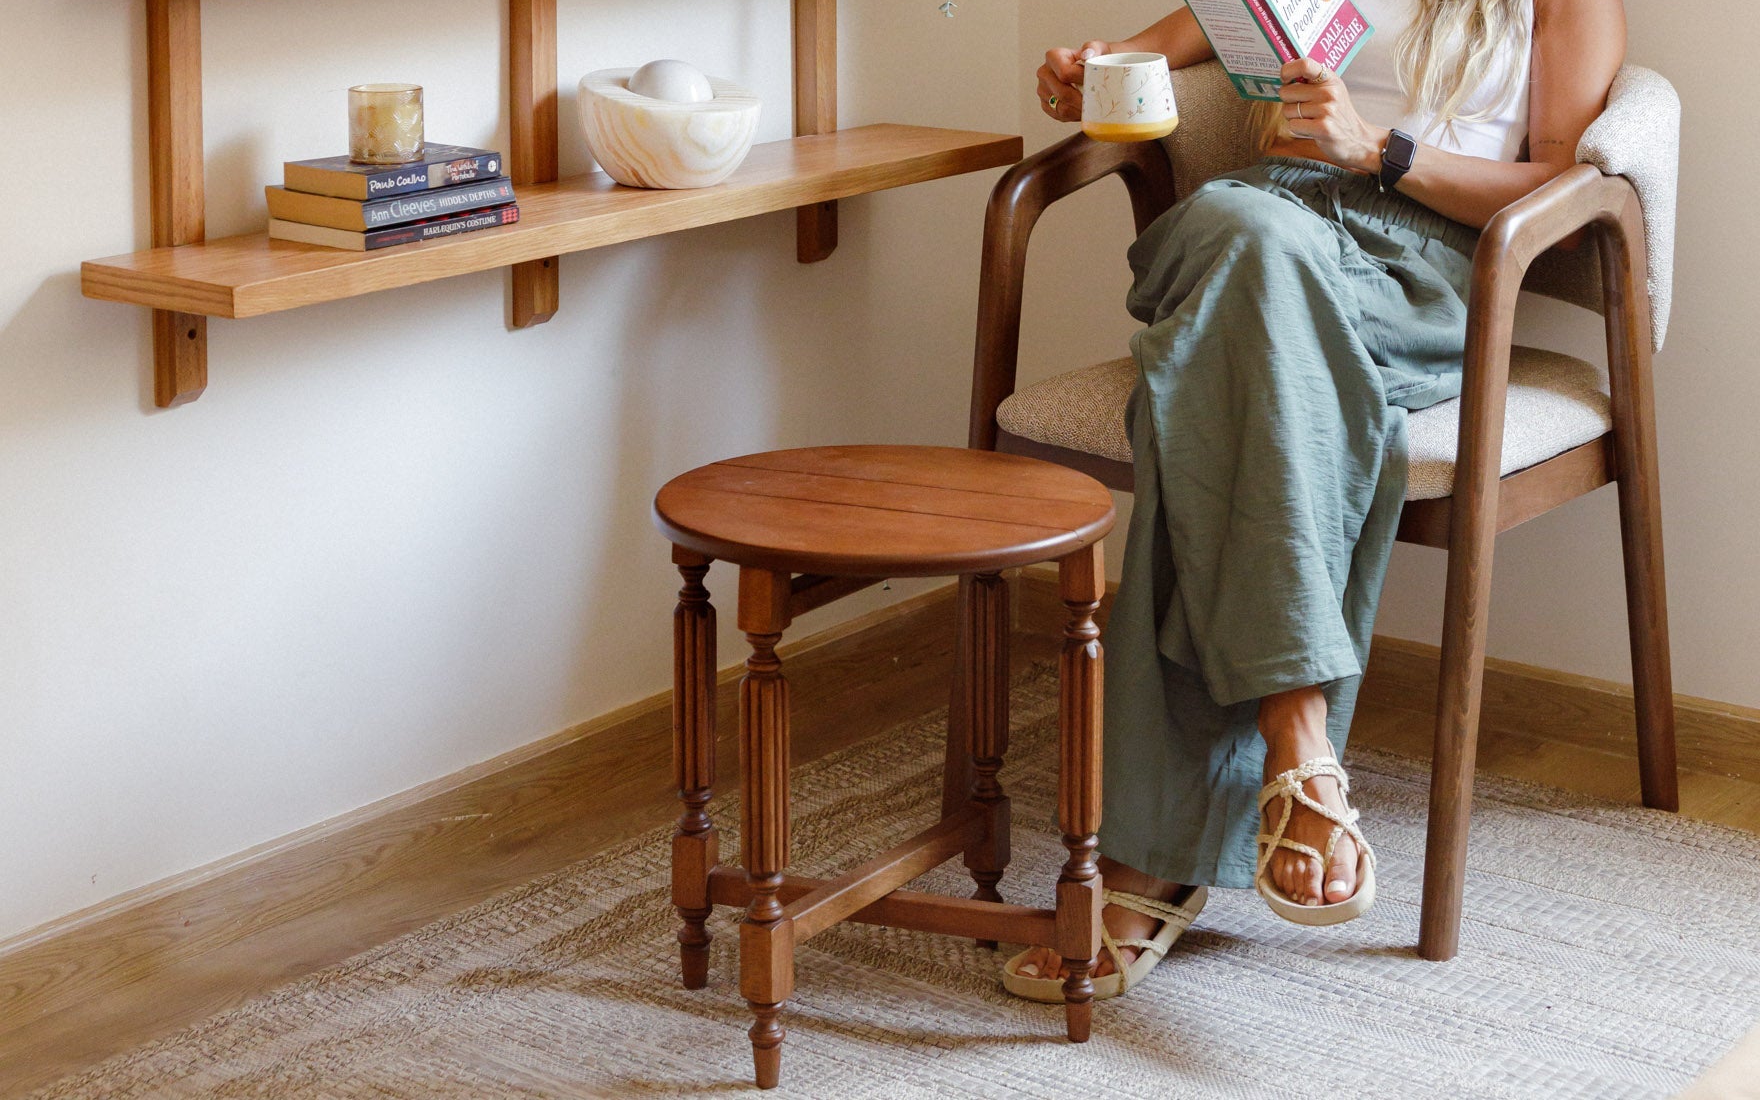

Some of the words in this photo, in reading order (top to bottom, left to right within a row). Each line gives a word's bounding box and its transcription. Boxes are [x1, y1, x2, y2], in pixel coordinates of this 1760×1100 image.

[1261, 11, 1269, 21] Win
[1266, 19, 1278, 37] Friends
[1320, 18, 1344, 53] DALE
[446, 165, 457, 174] The
[369, 177, 395, 193] Paulo
[396, 174, 427, 187] Coelho
[371, 209, 390, 222] Ann
[389, 199, 437, 219] Cleeves
[439, 194, 468, 207] HIDDEN
[468, 189, 496, 203] DEPTHS
[423, 221, 466, 237] HARLEQUIN'S
[466, 215, 497, 228] COSTUME
